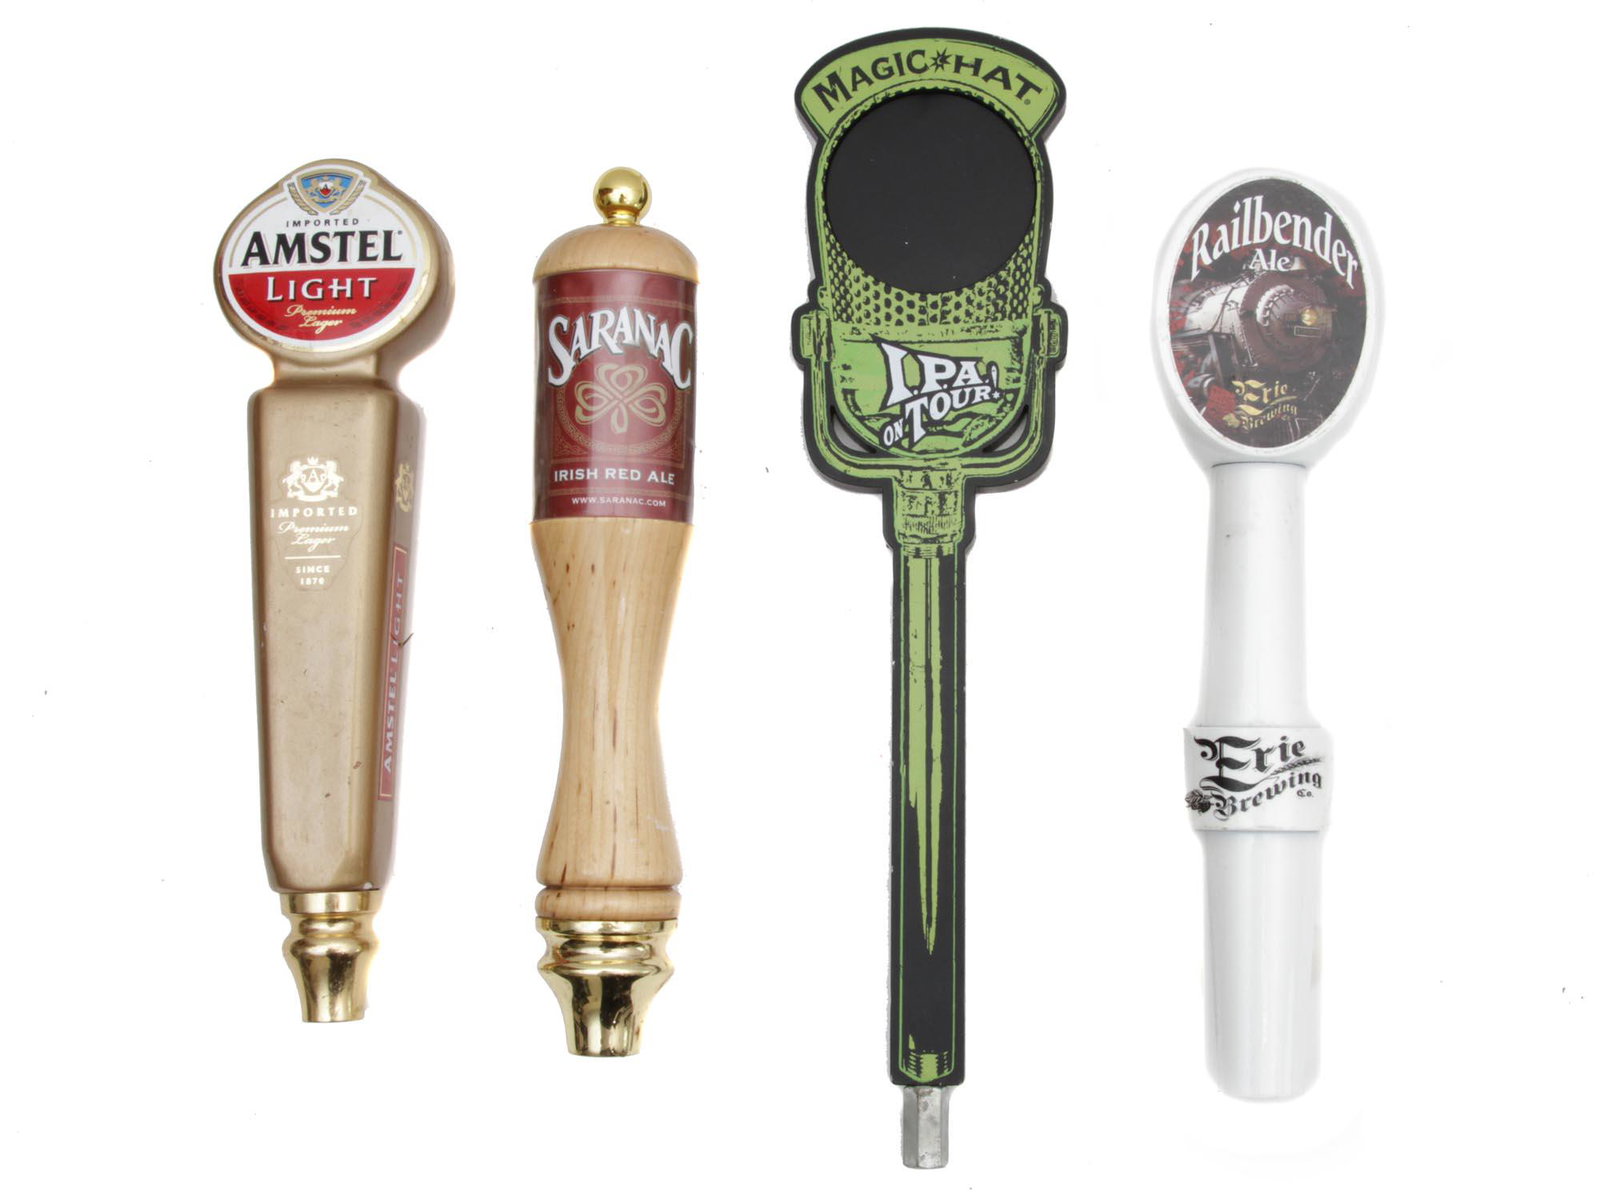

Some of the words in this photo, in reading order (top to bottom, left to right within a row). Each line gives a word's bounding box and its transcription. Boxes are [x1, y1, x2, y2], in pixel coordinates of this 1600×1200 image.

[812, 49, 928, 112] MAGIC
[953, 55, 1042, 101] HAT
[286, 218, 359, 228] IMPORTED
[1190, 195, 1358, 290] Railbender
[1249, 248, 1290, 272] Ale
[266, 276, 378, 302] LIGHT
[284, 304, 357, 318] Premium
[298, 316, 343, 335] Lager
[548, 306, 694, 388] SARANAC
[883, 418, 904, 447] ON
[554, 469, 598, 483] IRISH
[604, 468, 641, 482] RED
[647, 470, 675, 486] ALE
[270, 506, 358, 519] IMPORTED
[571, 496, 667, 508] WWW.SARANAC.COM
[277, 521, 349, 534] Premium
[291, 533, 336, 552] Lager
[295, 564, 330, 574] SINCE
[383, 672, 398, 774] AMSTEL
[1194, 735, 1306, 793] Erie
[1210, 771, 1323, 822] Brewing
